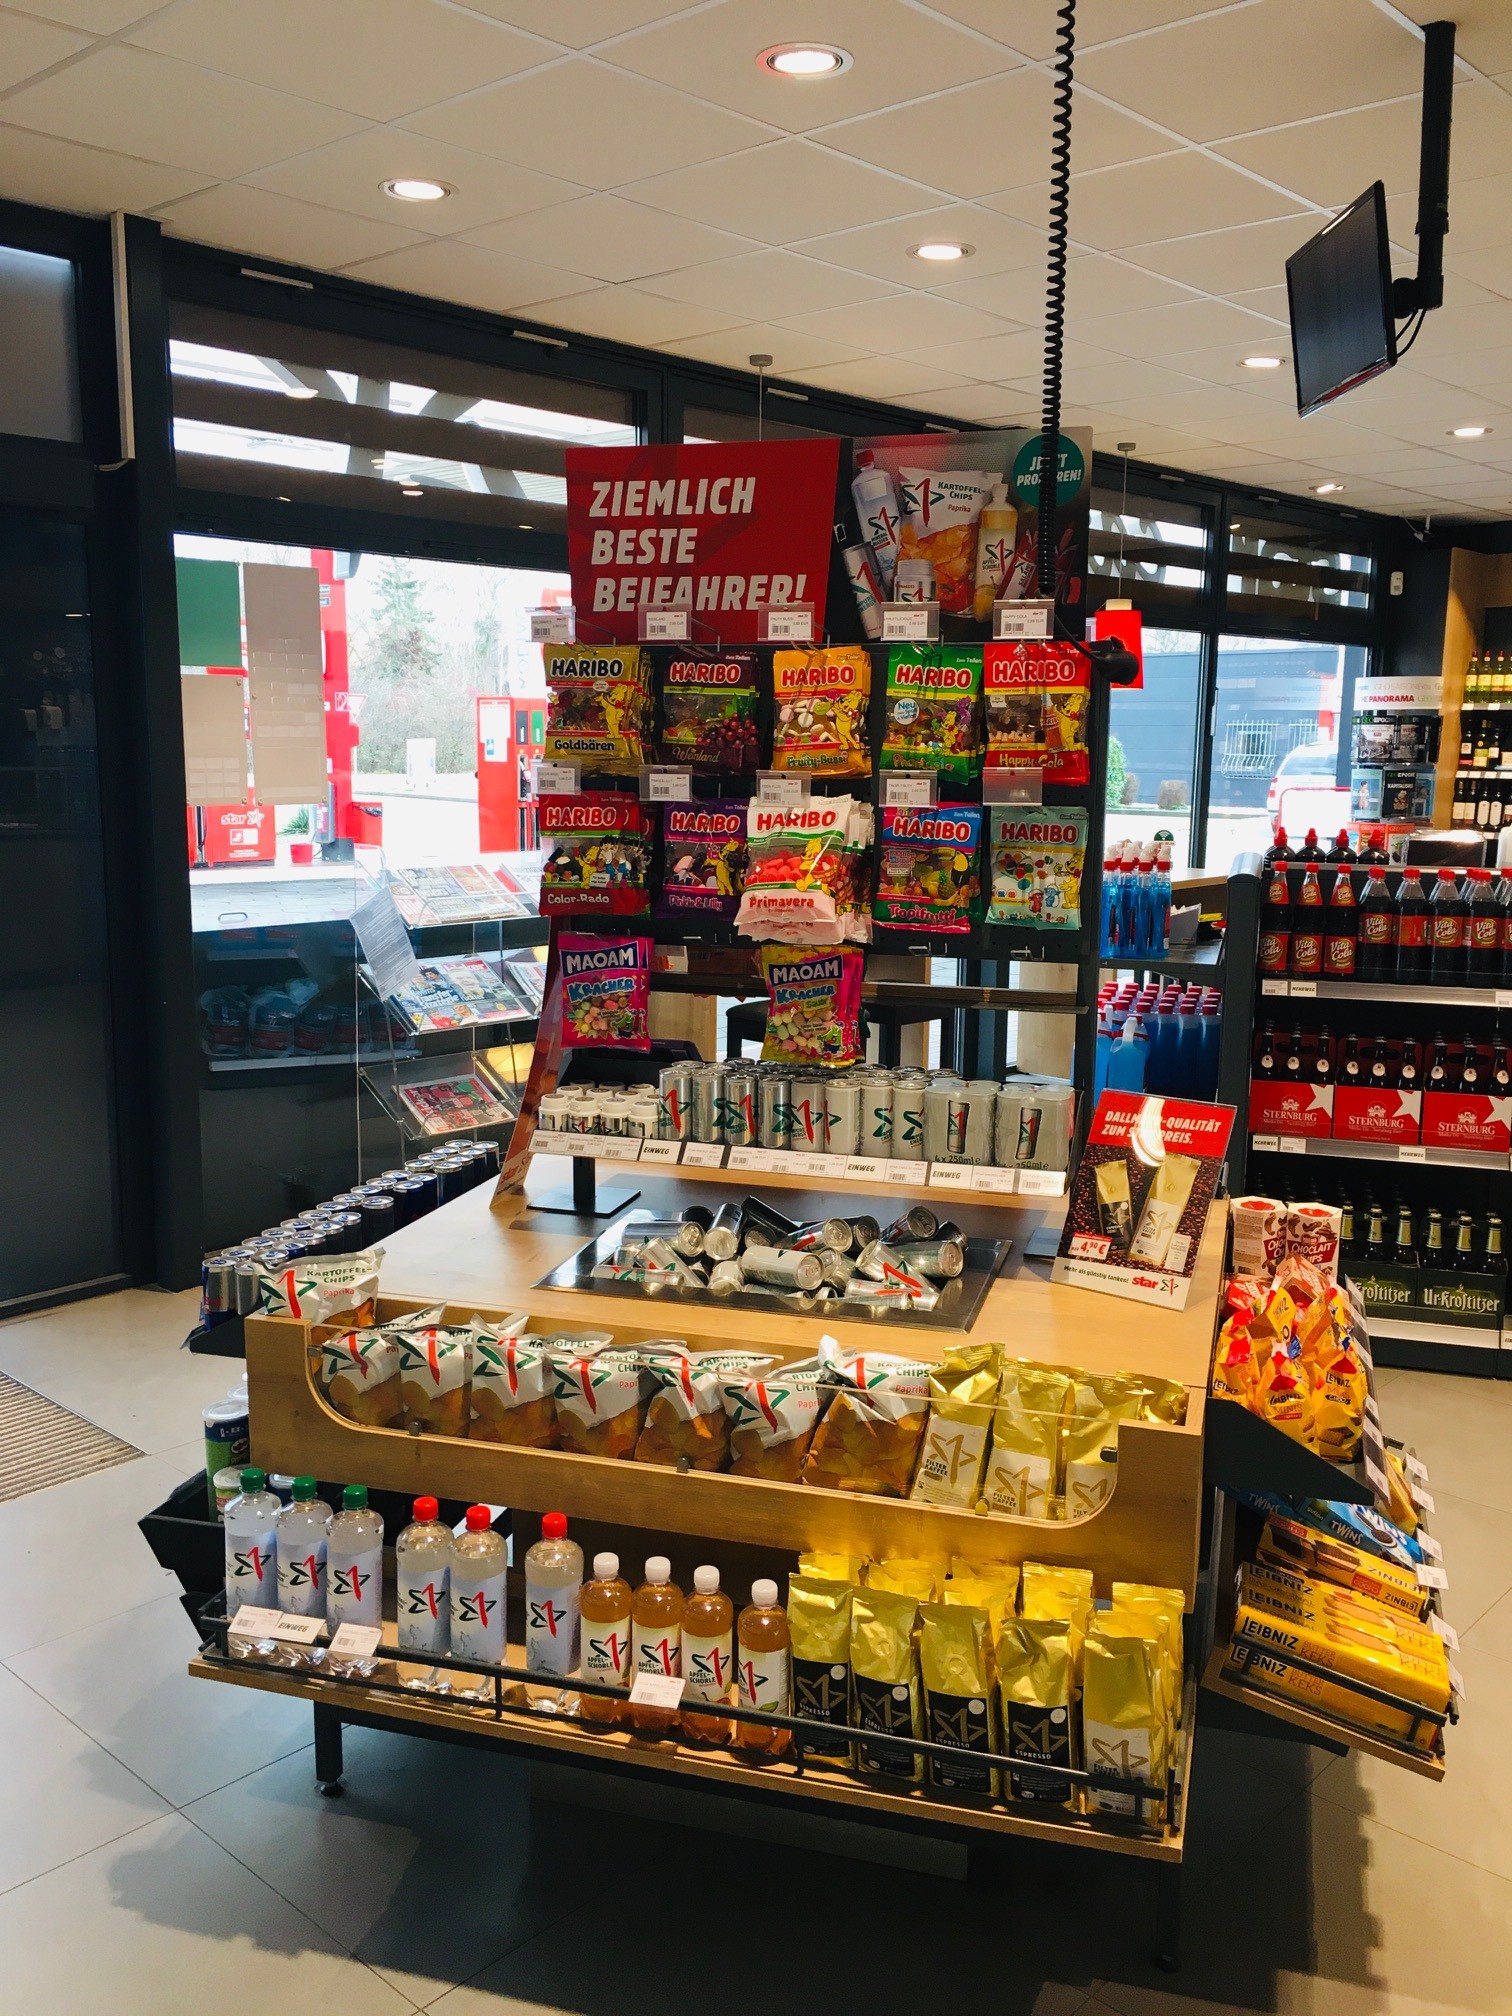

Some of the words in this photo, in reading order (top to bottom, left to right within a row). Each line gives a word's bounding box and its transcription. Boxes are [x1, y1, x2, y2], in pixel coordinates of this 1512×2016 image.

[1017, 469, 1082, 487] PROREN!
[589, 477, 756, 517] ZIEMLICH
[949, 490, 974, 501] CHIPS
[947, 504, 971, 513] Paprika
[591, 528, 698, 565] BESTE
[593, 574, 807, 612] BEIFAHRER!
[551, 658, 624, 678] HARIBO
[670, 662, 741, 684] HARIBO
[993, 659, 1076, 682] HARIBO
[781, 665, 855, 687] HARIBO
[895, 664, 972, 689] HARIBO
[898, 701, 916, 710] Neu
[1369, 695, 1415, 703] PANORAMA
[554, 739, 616, 751] Goldbären
[672, 746, 721, 763] Weinland
[786, 753, 848, 768] Fruity-Bussi
[221, 811, 247, 826] star
[546, 806, 617, 827] HARIBO
[670, 811, 740, 834] HARIBO
[756, 810, 838, 832] HARIBO
[893, 817, 971, 842] HARIBO
[1001, 822, 1079, 844] HARIBO
[547, 893, 610, 904] Color-Rado
[749, 896, 815, 909] Primavera
[888, 904, 957, 924] Tropifrutti
[1366, 917, 1384, 928] Vita
[1367, 923, 1388, 935] Cola
[1434, 920, 1452, 930] Vita
[1476, 921, 1494, 932] Vita
[1436, 927, 1457, 938] Cola
[1478, 928, 1496, 939] Cola
[1295, 939, 1315, 949] Vita
[1330, 940, 1351, 951] Vita
[1261, 945, 1281, 957] Cola
[1297, 946, 1318, 959] Cola
[1332, 949, 1354, 961] Cola
[566, 947, 634, 974] MAOAM
[773, 960, 839, 984] MAOAM
[567, 977, 637, 1003] KRACHER
[775, 985, 837, 1005] KRACHER
[1105, 1111, 1222, 1132] DALLM-QUALITÄT
[1263, 1109, 1317, 1122] STERNBURG
[1349, 1115, 1405, 1129] STERNBURG
[1101, 1124, 1126, 1137] ZUM
[1437, 1121, 1496, 1135] STERNBURG
[644, 1146, 670, 1155] EINWEG
[949, 1155, 974, 1164] 250ml
[847, 1163, 876, 1172] EINWEG
[932, 1170, 961, 1180] EINWEG
[1098, 1244, 1107, 1255] €
[1291, 1243, 1333, 1255] CHOCLAIT
[306, 1266, 373, 1278] KARTOFFEL-
[1063, 1265, 1078, 1273] Mehr
[1086, 1270, 1107, 1280] günstig
[1108, 1274, 1130, 1284] tanken!
[323, 1274, 356, 1284] CHIPS
[1132, 1276, 1159, 1289] star
[323, 1287, 355, 1298] Paprika
[896, 1369, 930, 1378] CHIPS
[895, 1384, 928, 1395] Paprika
[924, 1464, 949, 1477] KAFFEE
[926, 1458, 948, 1471] FILTER
[993, 1492, 1016, 1502] FILTER
[1249, 1491, 1282, 1515] TWINS
[1330, 1520, 1364, 1546] TWINS
[1249, 1563, 1314, 1597] LEIBNIZ
[1249, 1588, 1315, 1622] LEIBNIZ
[1384, 1592, 1419, 1613] LEIBNIZ
[278, 1621, 310, 1633] EINWEG
[1242, 1616, 1300, 1650] LEIBNIZ
[1231, 1648, 1289, 1678] LEBNIZ
[1300, 1649, 1336, 1668] KEKS
[1288, 1675, 1323, 1696] KEKS
[799, 1703, 831, 1716] ESPRESSO
[864, 1717, 895, 1734] ESPRESSO
[935, 1737, 971, 1748] ESPRESSO
[1015, 1749, 1052, 1760] ESPRESSO
